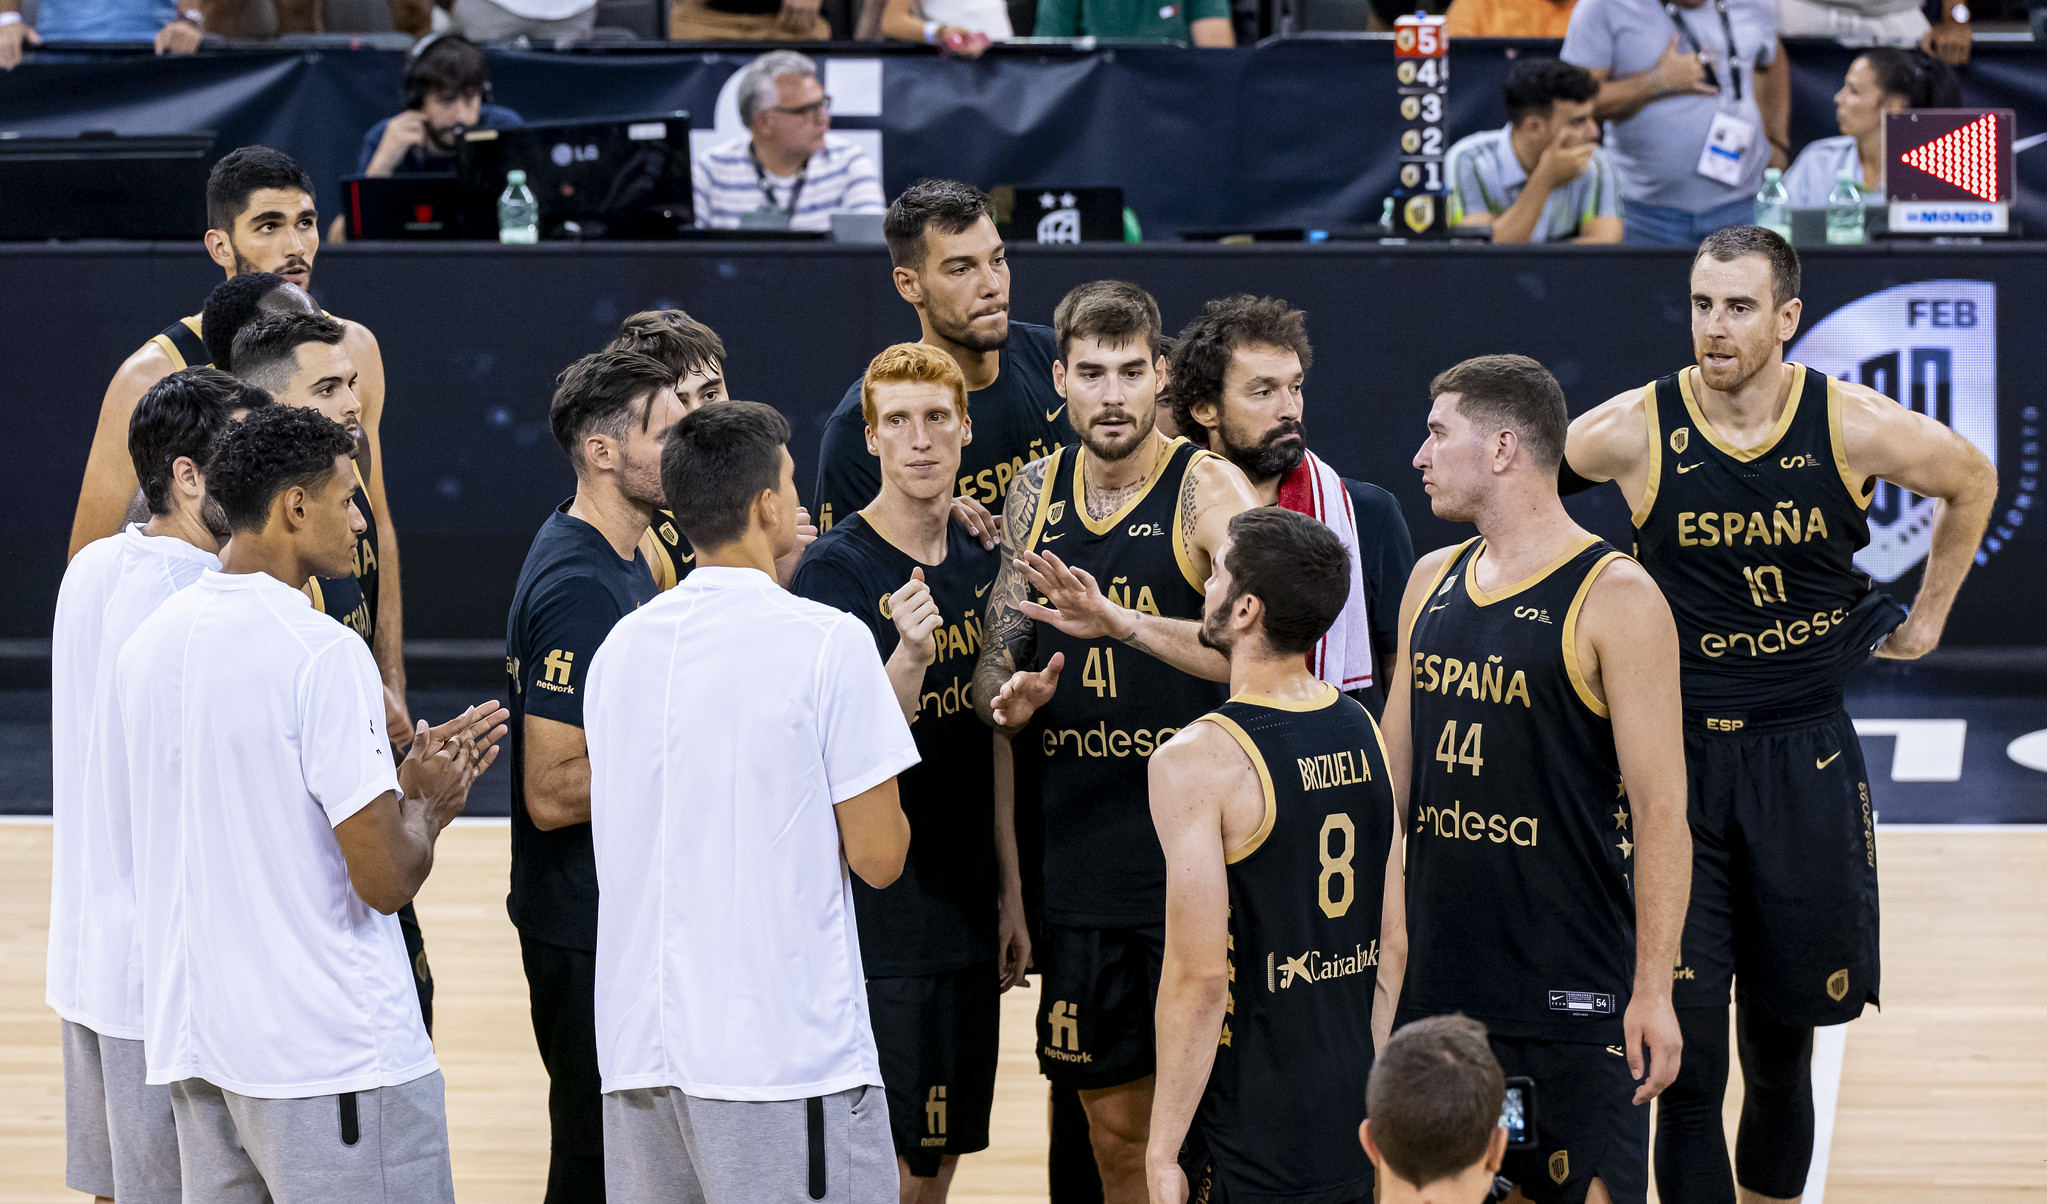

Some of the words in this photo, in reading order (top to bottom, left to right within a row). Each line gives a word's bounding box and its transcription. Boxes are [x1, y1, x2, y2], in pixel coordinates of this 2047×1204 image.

[1417, 27, 1438, 54] 5
[1416, 59, 1438, 87] 4
[1421, 93, 1442, 123] 3
[1421, 127, 1442, 155] 2
[1425, 163, 1442, 190] 1
[1921, 211, 1993, 223] MONDO
[1908, 300, 1976, 327] FEB
[959, 438, 1062, 504] ESPAÑ
[1678, 500, 1828, 547] ESPAÑA
[1742, 565, 1787, 607] 10
[544, 649, 574, 685] fi
[1082, 647, 1117, 698] 41
[1413, 652, 1531, 708] ESPAÑA
[536, 680, 575, 695] network
[1707, 718, 1744, 731] ESP
[1436, 720, 1484, 776] 44
[1297, 749, 1372, 791] BRIZUELA
[1319, 813, 1355, 919] 8
[1596, 998, 1607, 1008] 54
[1048, 1000, 1079, 1051] fi
[1044, 1046, 1093, 1063] network
[926, 1085, 947, 1134] fi
